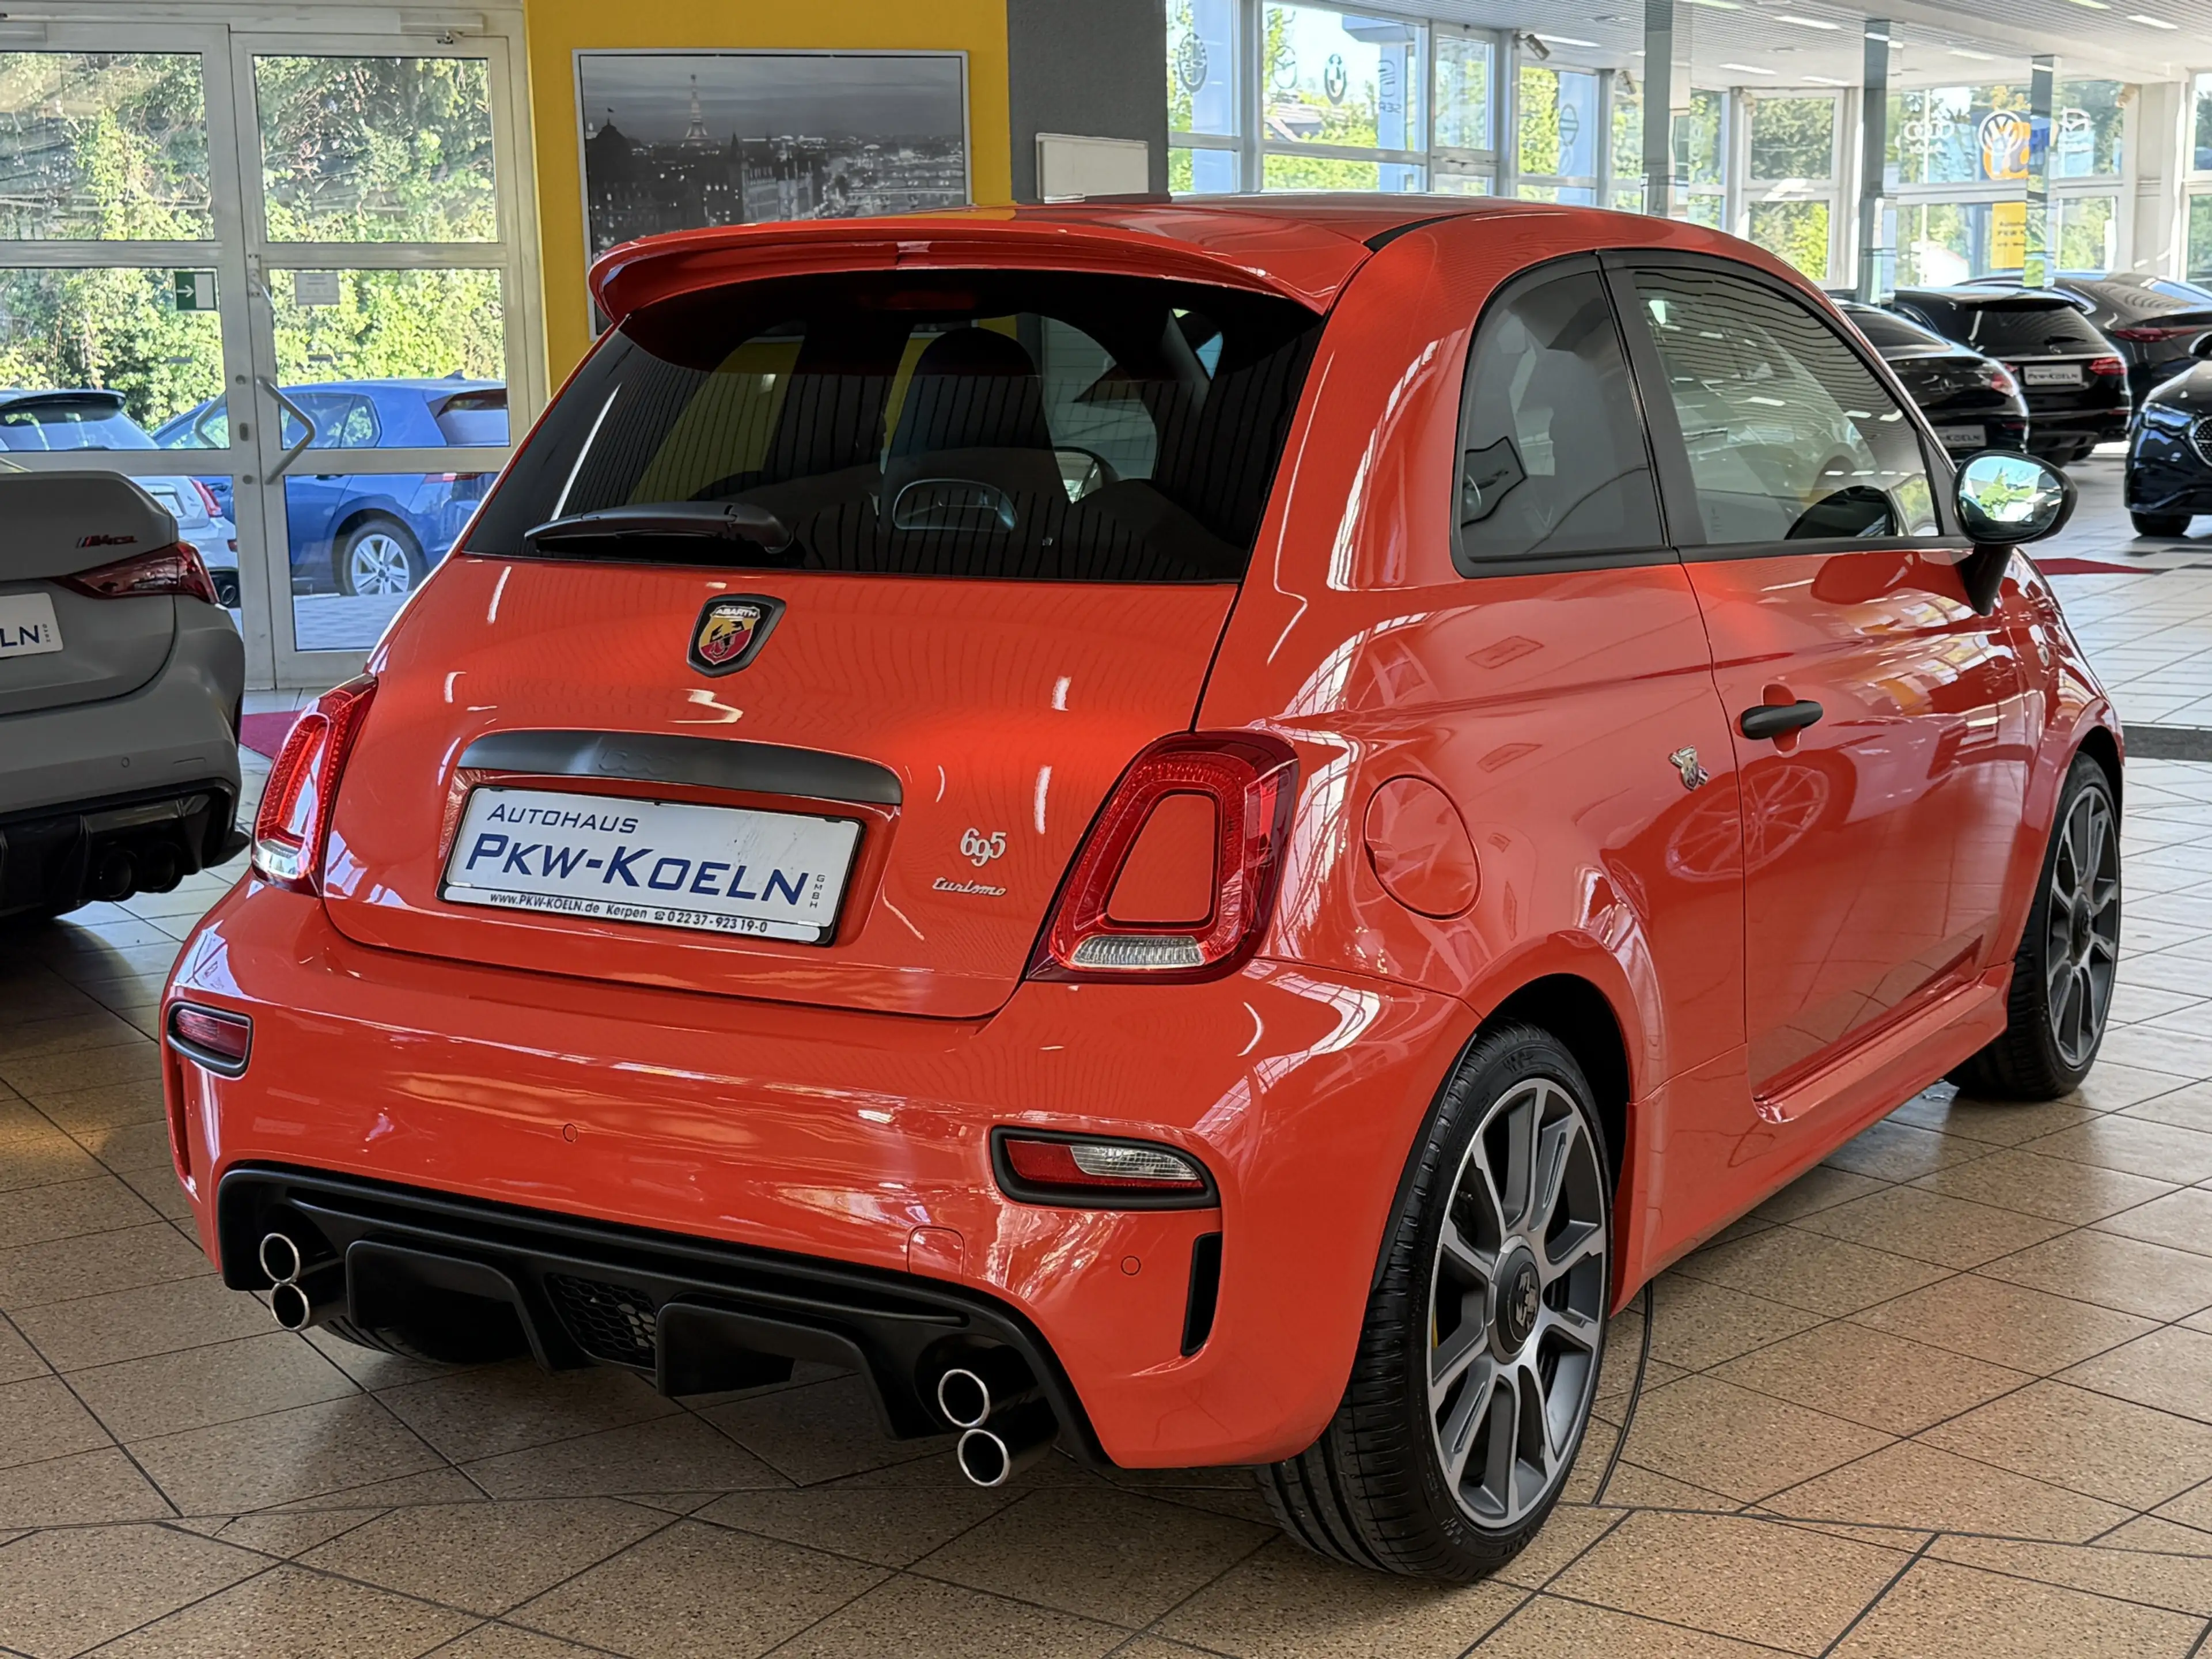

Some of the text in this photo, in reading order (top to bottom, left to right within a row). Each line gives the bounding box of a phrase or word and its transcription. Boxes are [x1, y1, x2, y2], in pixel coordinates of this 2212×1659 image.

[715, 608, 757, 618] ABARTH
[487, 804, 639, 834] AUTOHAUS
[960, 828, 1007, 867] 695
[465, 833, 809, 906] PKW-KOELN
[490, 893, 600, 914] www.PKW-KOELN.de
[606, 905, 647, 919] Kerpen
